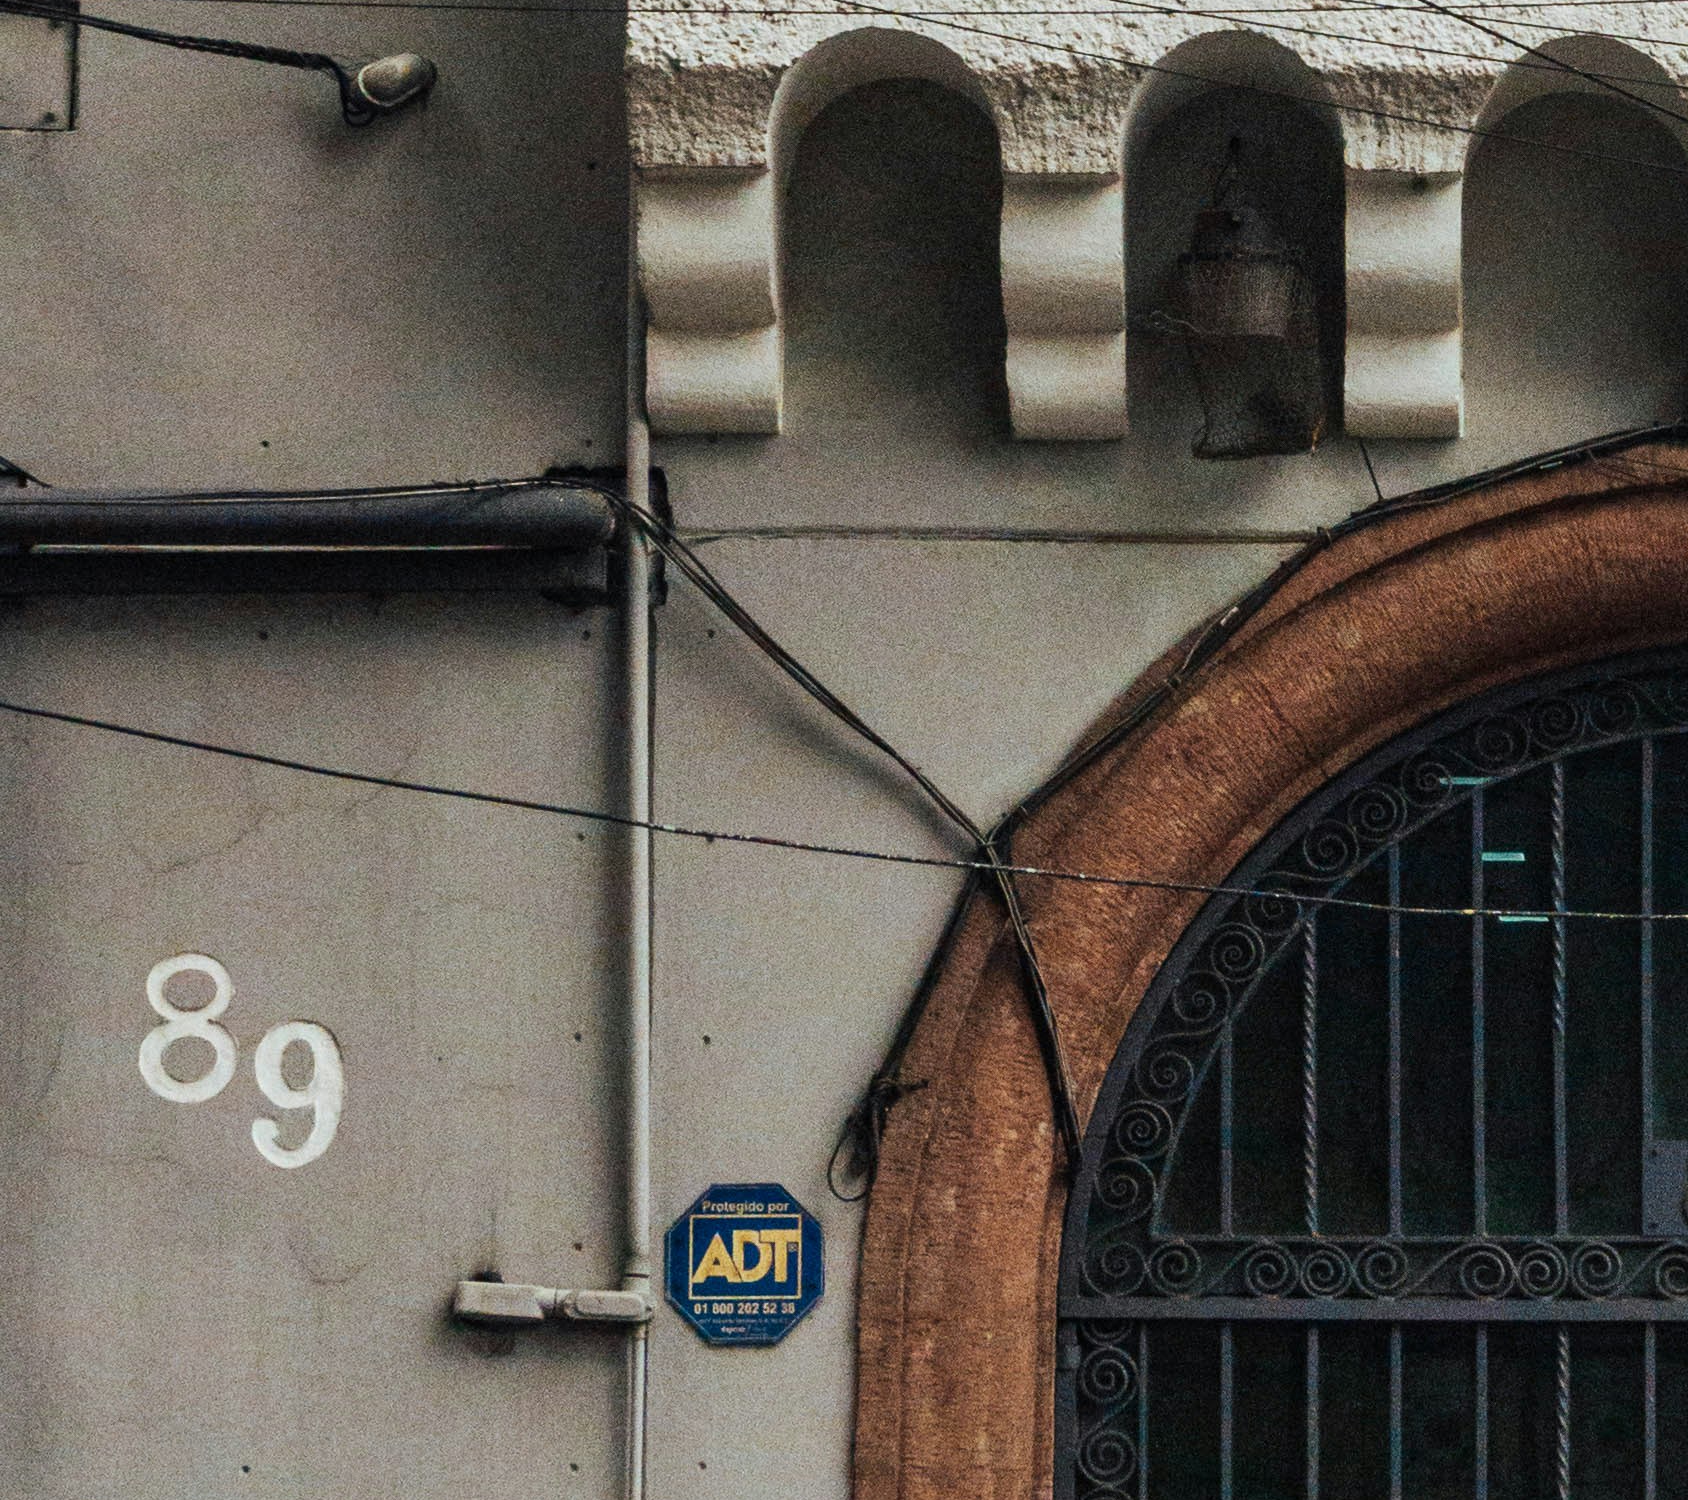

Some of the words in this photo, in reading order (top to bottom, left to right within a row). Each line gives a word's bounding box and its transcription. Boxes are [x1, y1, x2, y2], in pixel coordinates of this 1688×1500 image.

[138, 953, 344, 1170] 89
[702, 1201, 765, 1215] Protegido
[767, 1202, 790, 1214] por
[691, 1229, 800, 1284] ADT
[694, 1302, 708, 1315] 01
[712, 1302, 734, 1315] 800
[737, 1302, 760, 1315] 202
[762, 1302, 777, 1314] 52
